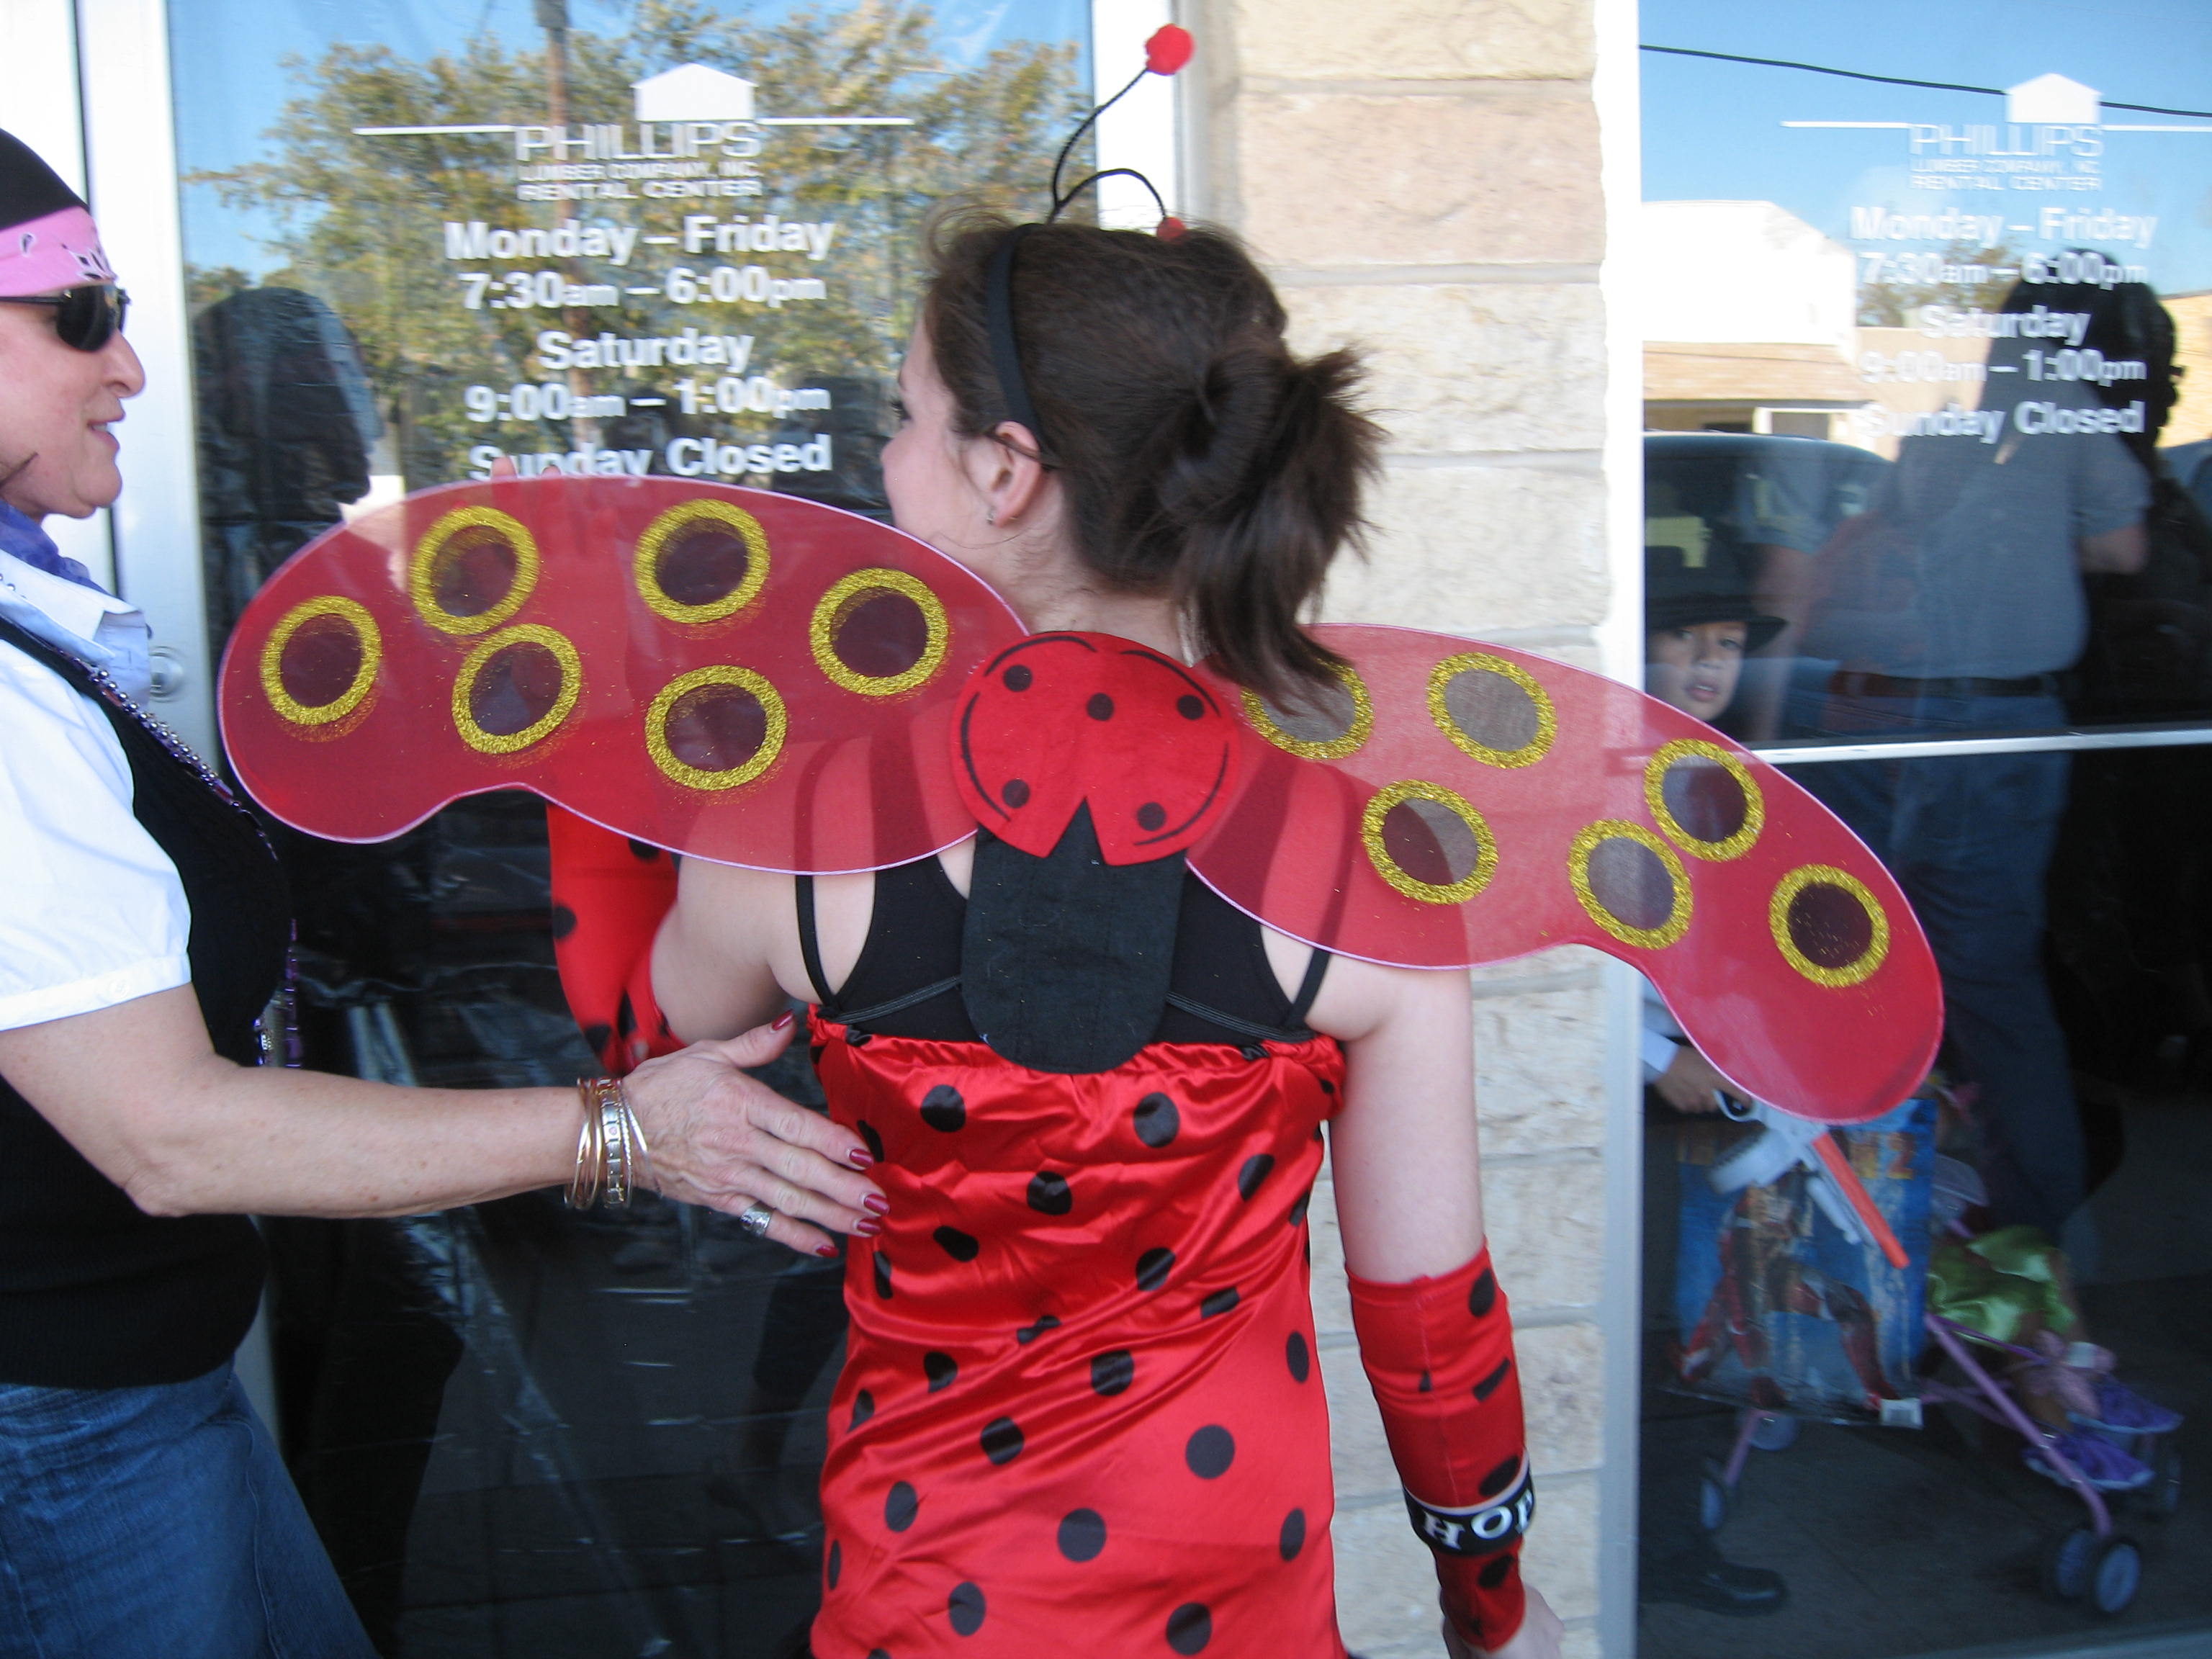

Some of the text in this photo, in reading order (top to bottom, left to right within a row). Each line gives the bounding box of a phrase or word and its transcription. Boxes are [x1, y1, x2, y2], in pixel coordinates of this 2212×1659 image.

[515, 122, 762, 161] PHILLIPS
[1910, 124, 2104, 157] PHILLIPS
[517, 163, 606, 181] LUMBER
[517, 180, 763, 201] RENTAL CENTER
[1910, 175, 2103, 192] RENTAL CENTER
[444, 218, 639, 266] Monday
[684, 215, 835, 261] Friday
[1851, 206, 2005, 249] Monday
[2039, 207, 2158, 249] Friday
[457, 270, 619, 310] 7:30am
[665, 265, 827, 308] 6:00pm
[1858, 251, 1989, 284] 7:30am
[2021, 251, 2149, 290] 6:00pm
[1920, 304, 2091, 346] Saturday
[537, 327, 755, 373] Saturday
[1859, 350, 1987, 383] 9:00am
[2022, 349, 2147, 387] 1:00pm
[464, 383, 626, 423] 9:00am
[673, 376, 831, 419] 1:00pm
[1858, 400, 2146, 444] Sunday Closed
[469, 433, 832, 482] Sunday Closed
